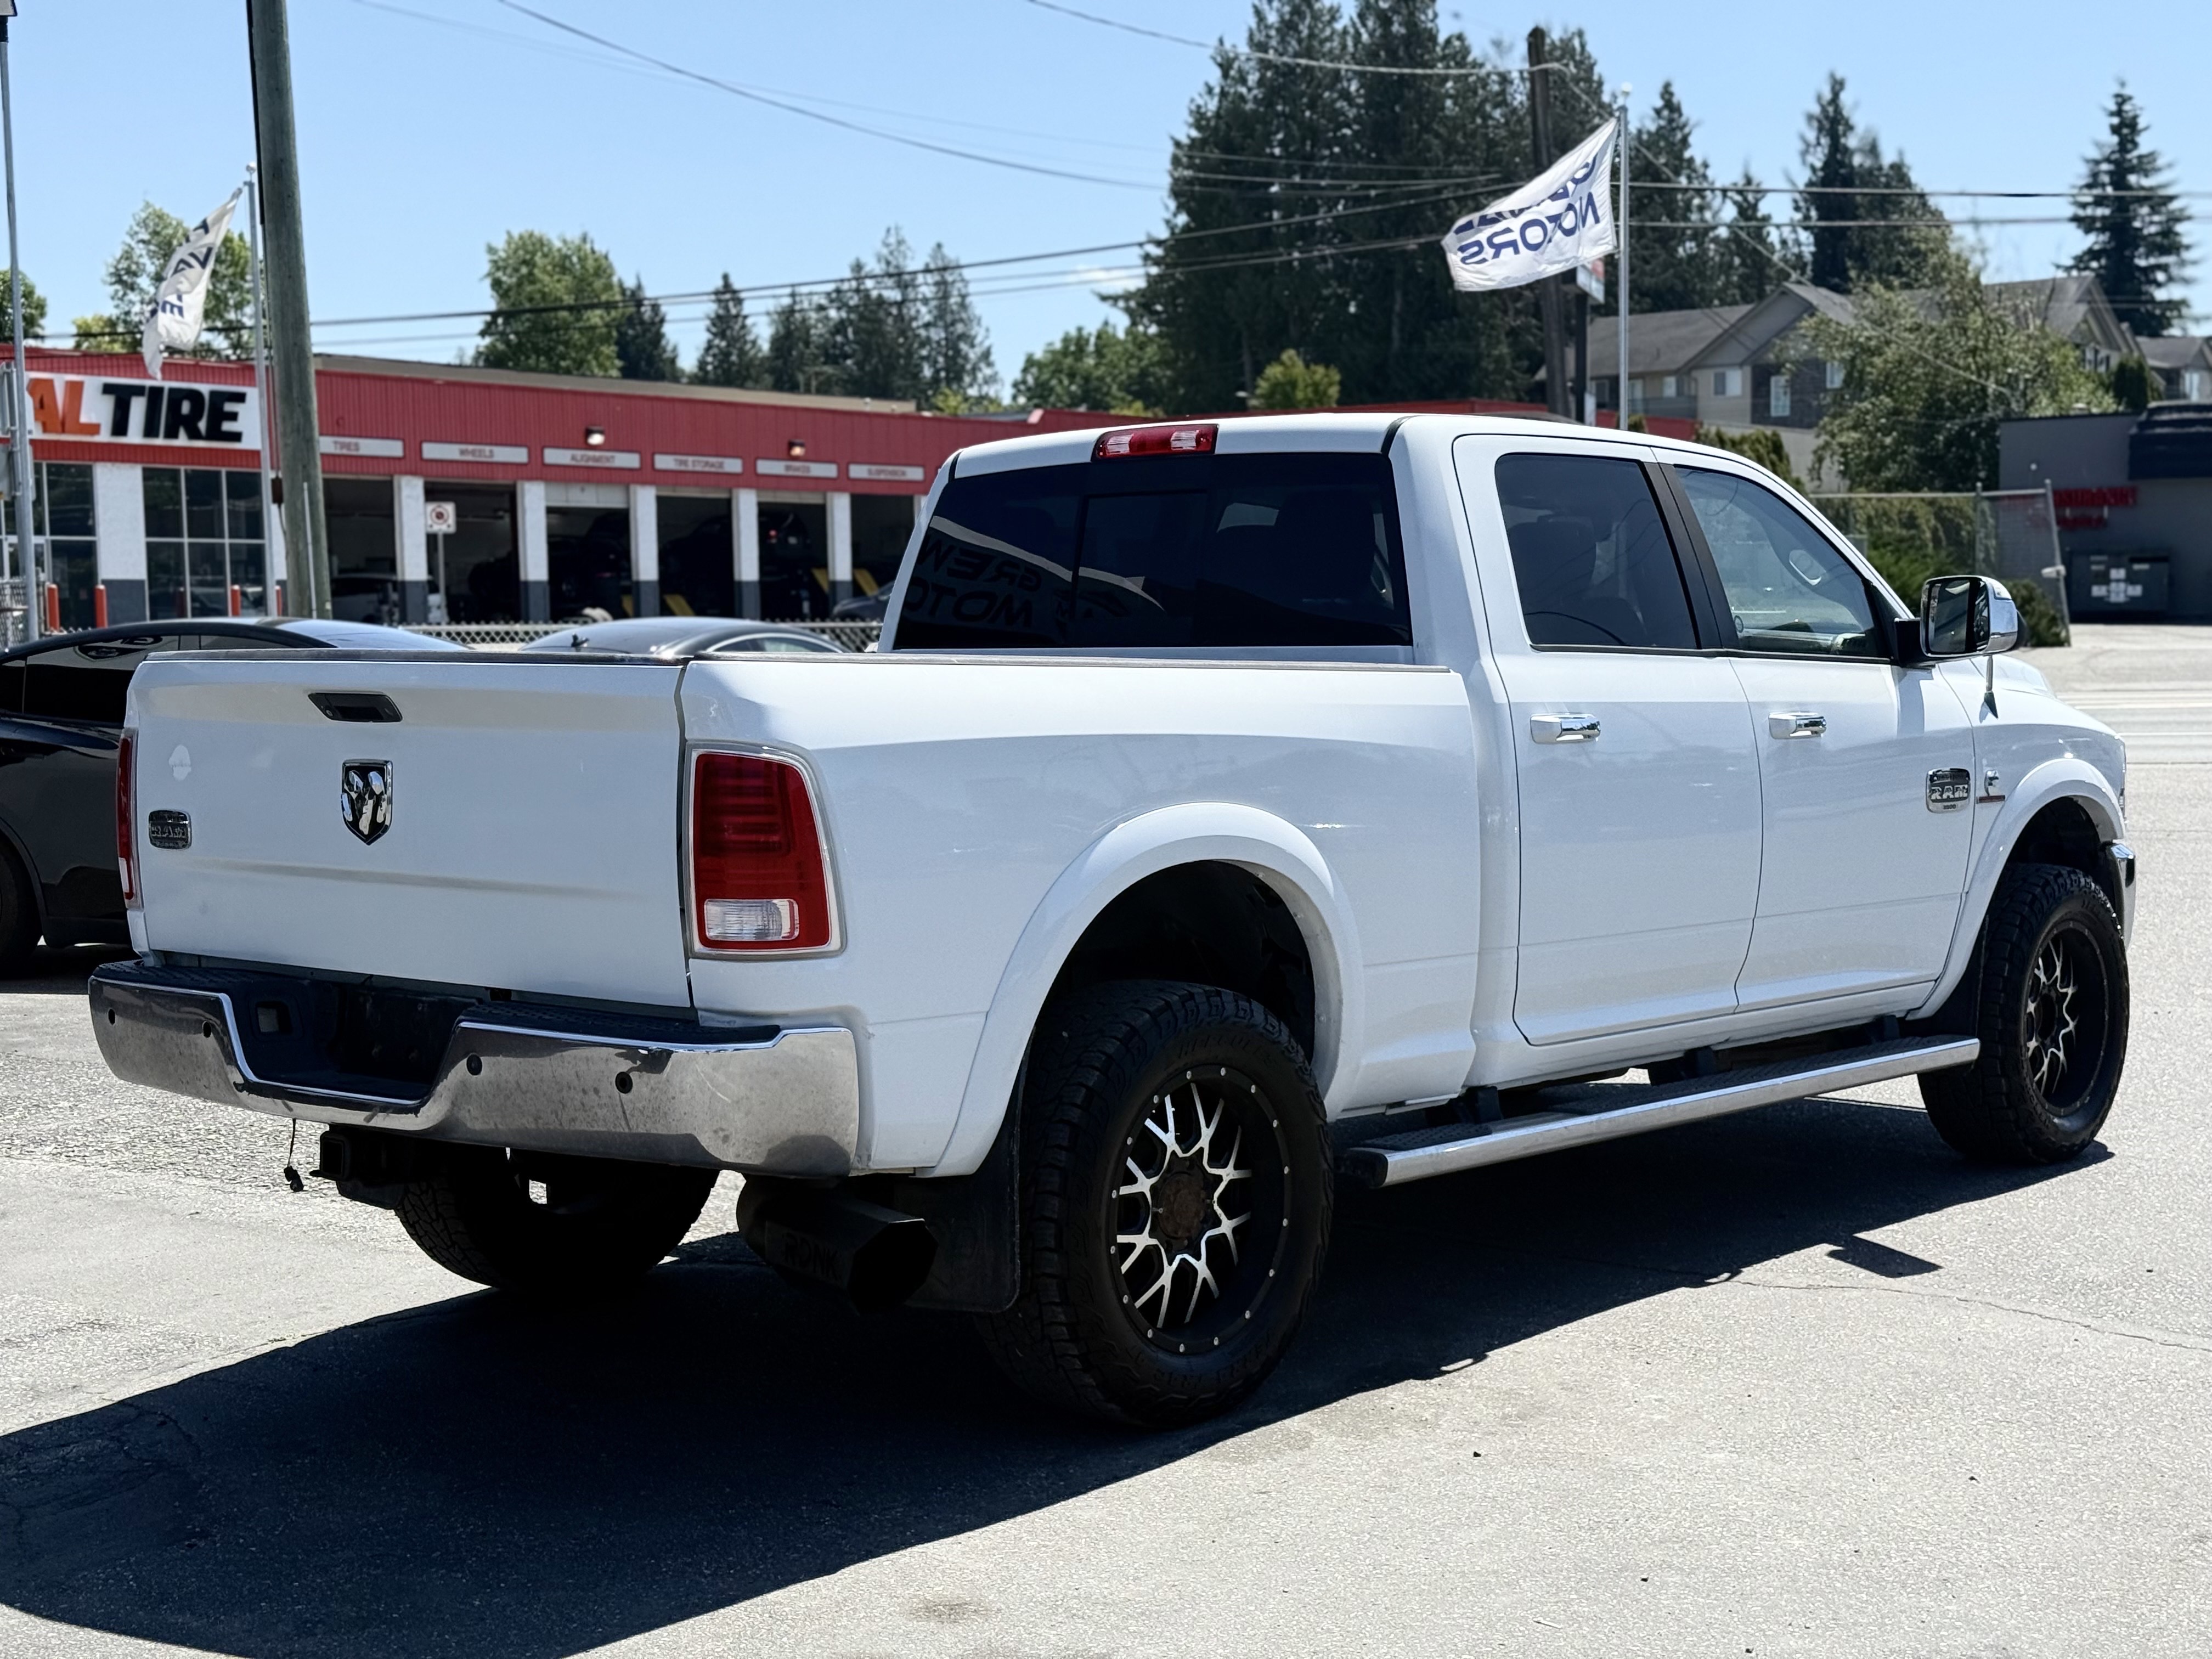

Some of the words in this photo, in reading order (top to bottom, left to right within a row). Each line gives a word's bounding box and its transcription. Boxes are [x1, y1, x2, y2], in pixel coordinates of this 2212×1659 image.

[103, 382, 246, 443] TIRE
[332, 440, 360, 452] TIRES
[459, 447, 494, 458] WHEELS
[571, 453, 616, 464] ALIGNMENT
[673, 458, 689, 467] TIRE
[1930, 785, 1968, 800] RAM
